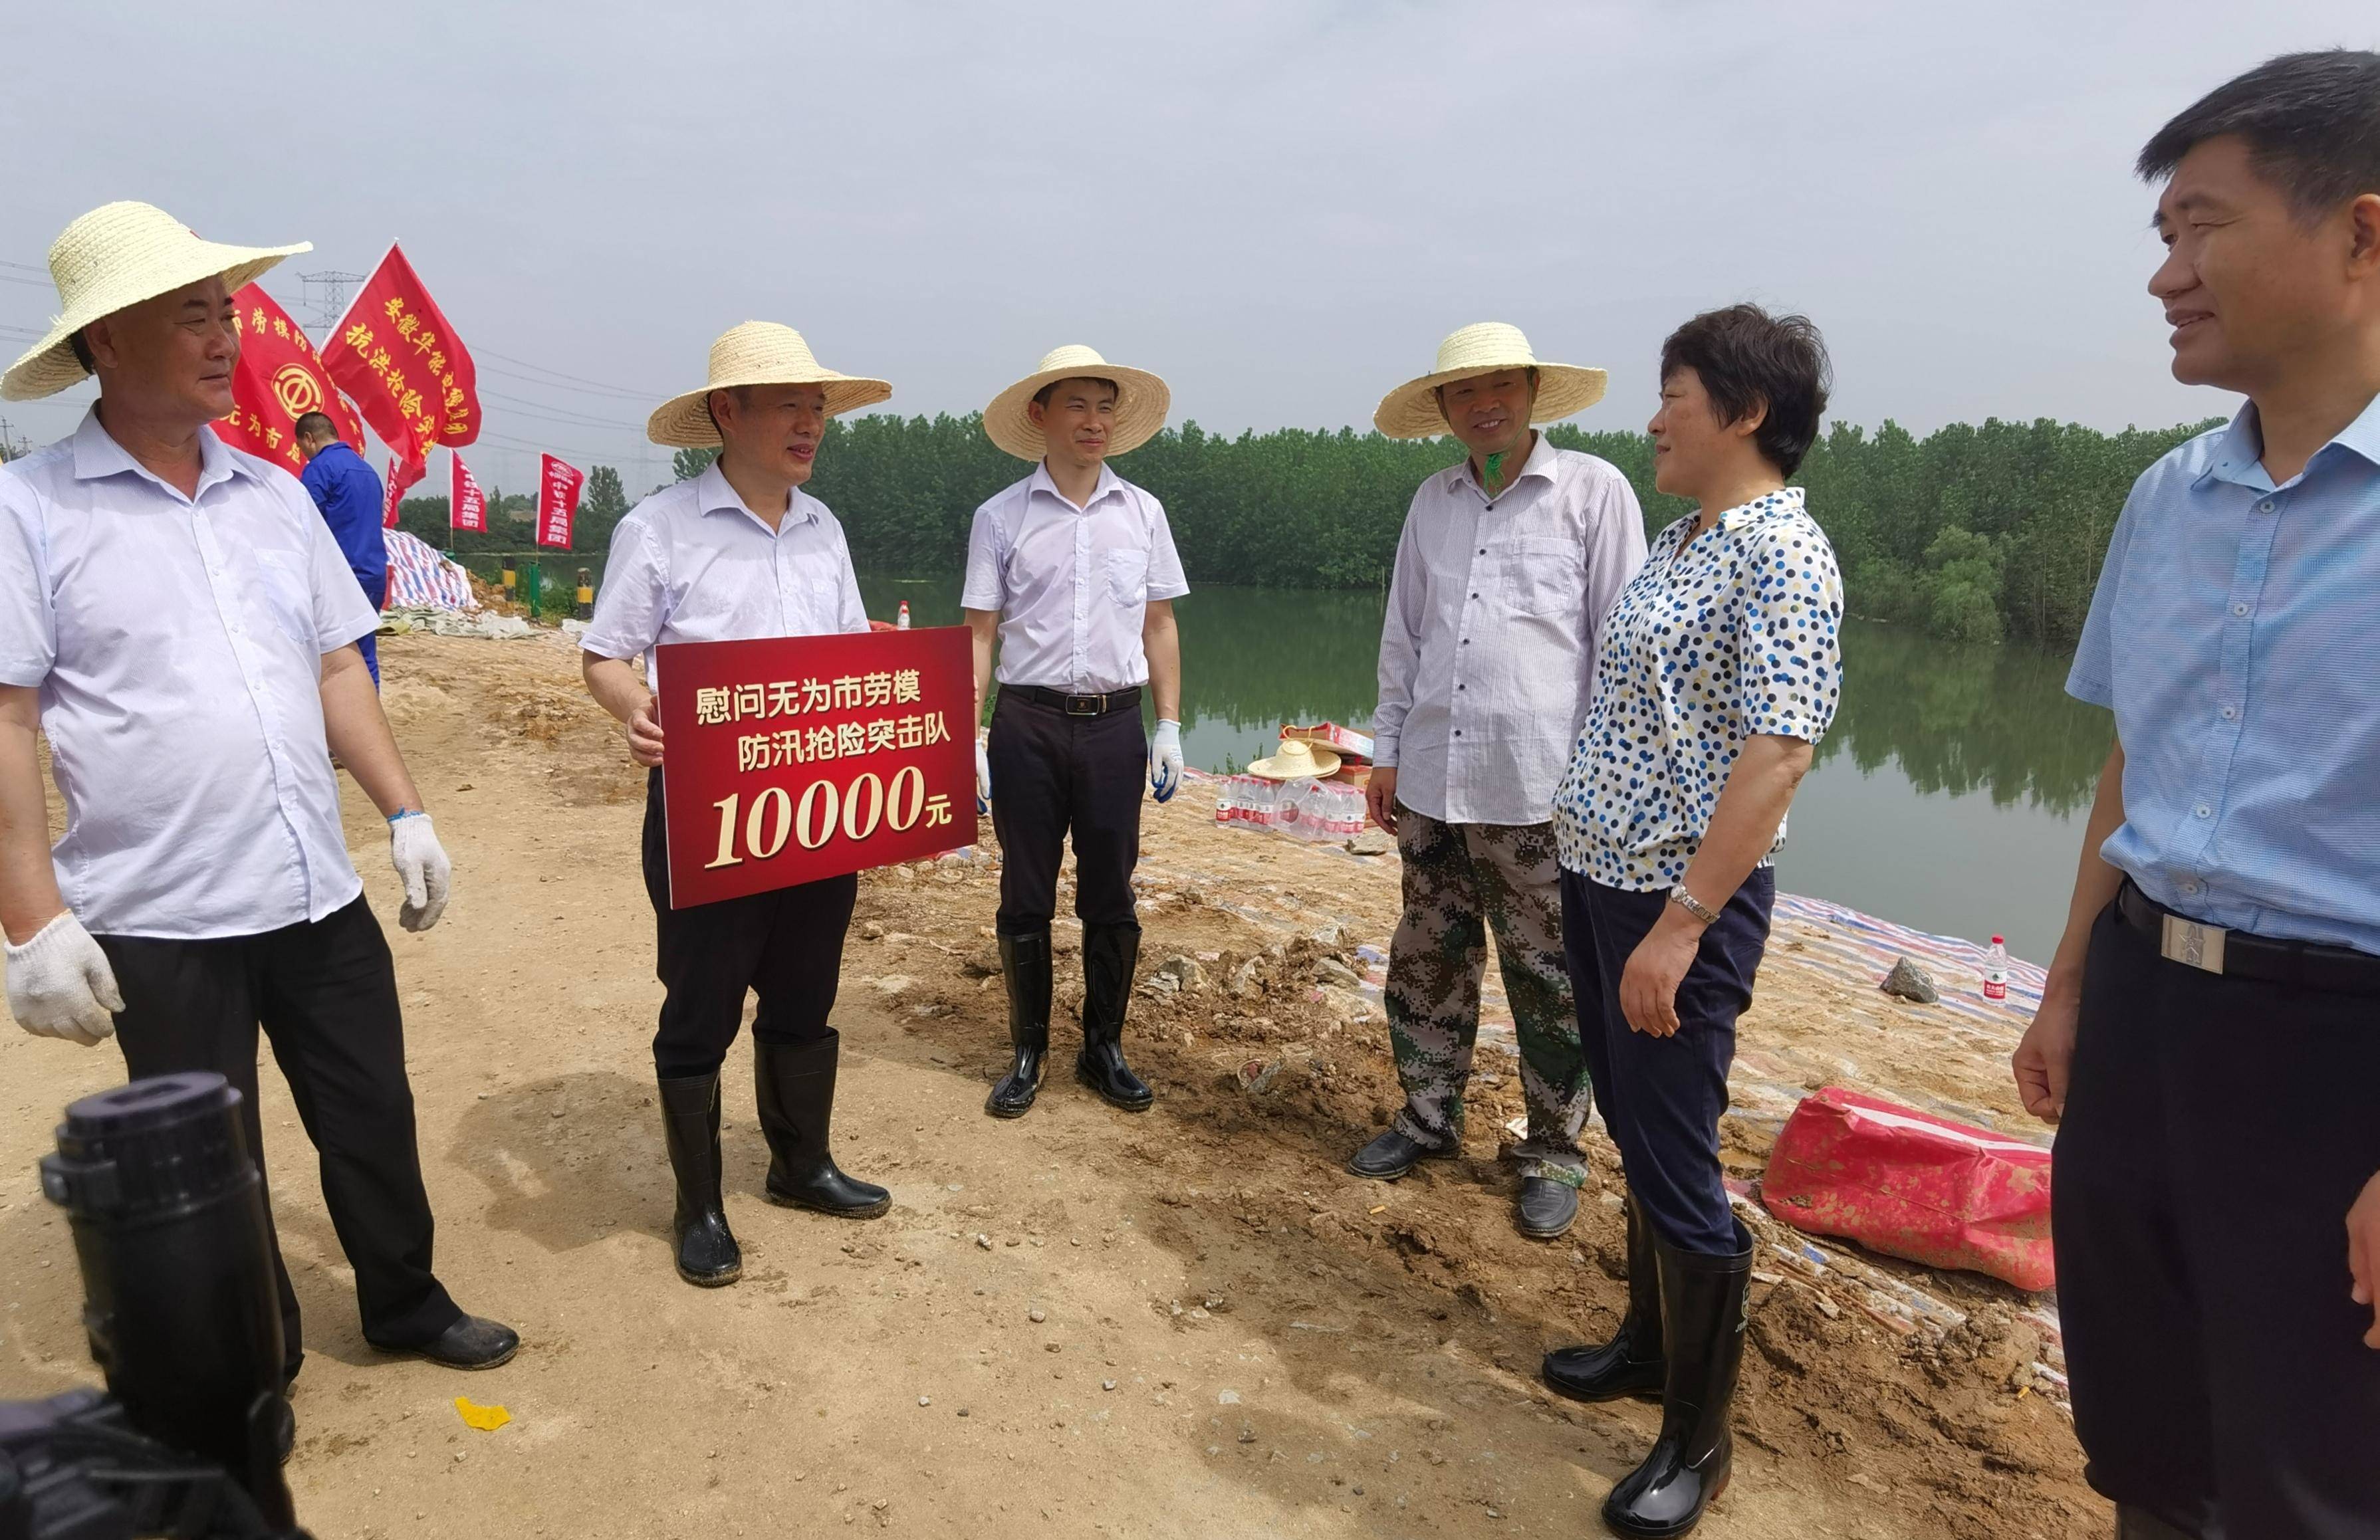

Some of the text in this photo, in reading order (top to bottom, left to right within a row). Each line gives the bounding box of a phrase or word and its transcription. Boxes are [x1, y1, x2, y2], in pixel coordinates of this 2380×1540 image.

[384, 297, 469, 435] 安徽华能电缆集团
[696, 669, 921, 725] 慰问无为市劳模
[738, 711, 951, 772] 防汛抢险突击队
[704, 766, 953, 870] 10000元
